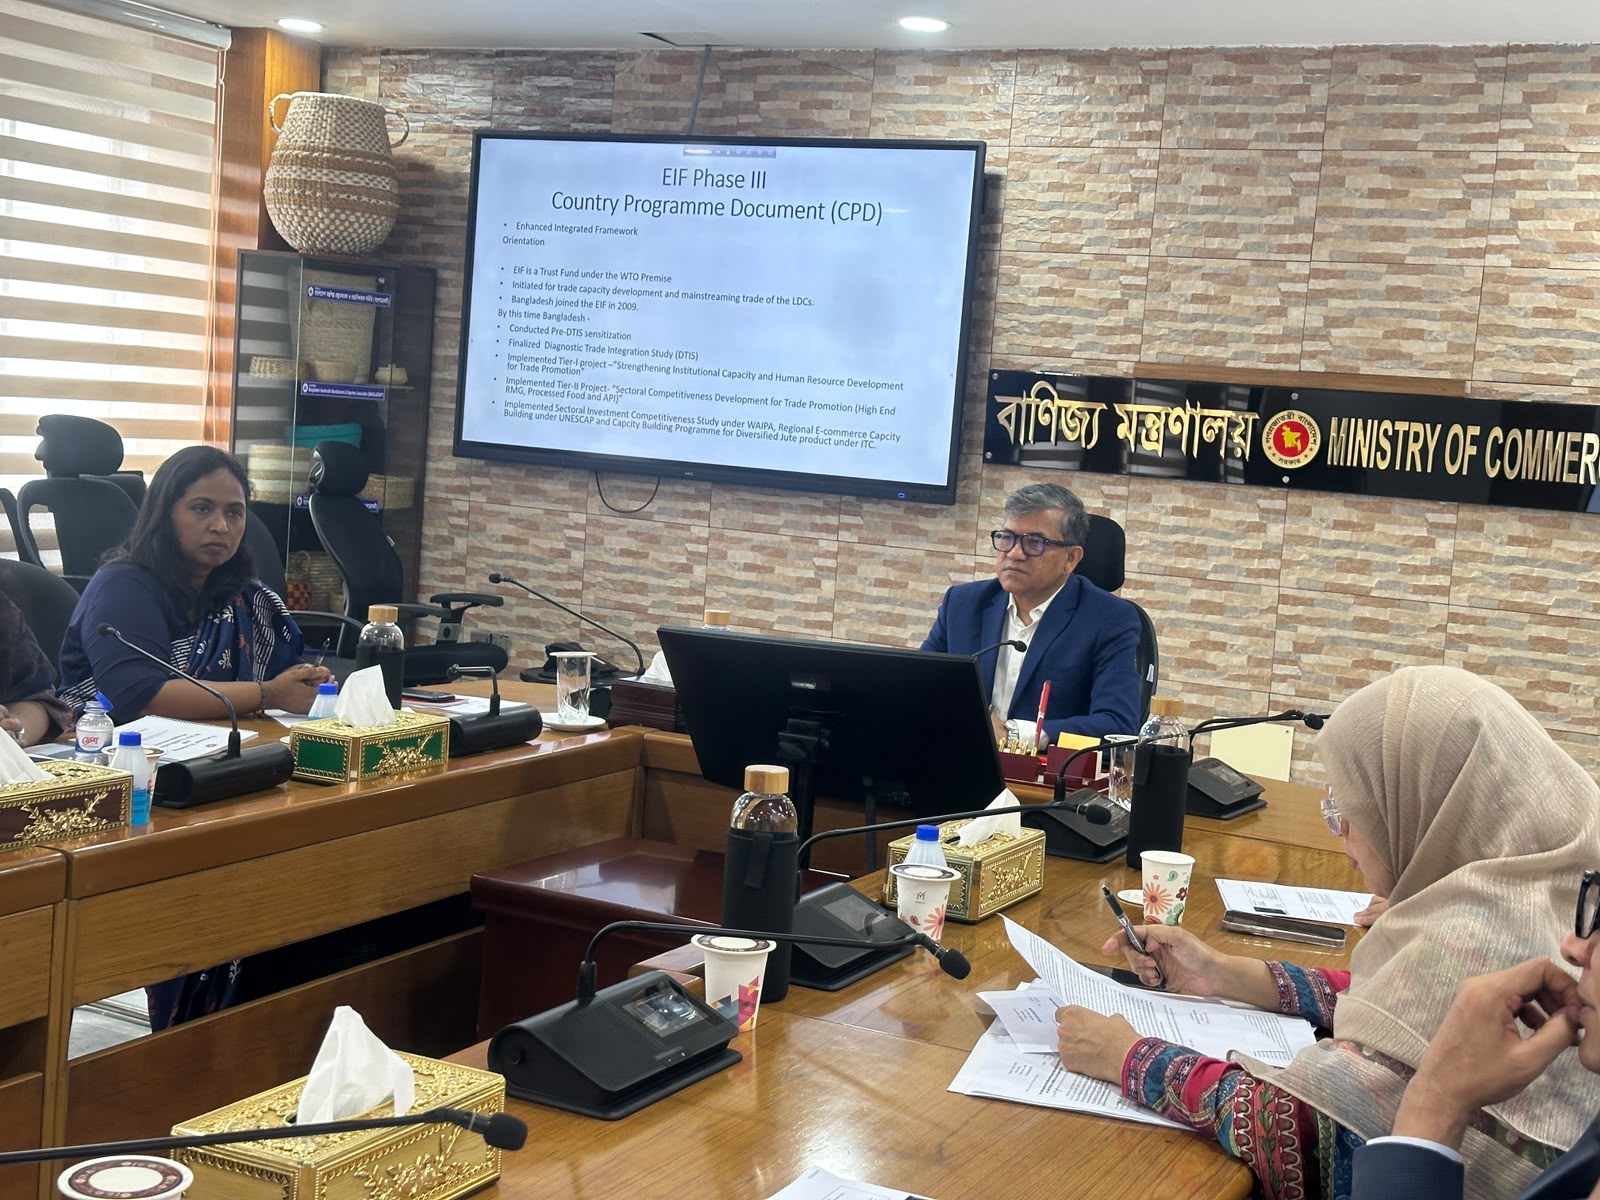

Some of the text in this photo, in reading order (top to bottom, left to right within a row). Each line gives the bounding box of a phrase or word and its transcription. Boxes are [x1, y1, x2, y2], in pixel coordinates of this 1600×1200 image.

[662, 168, 766, 189] EIF Phase III
[552, 191, 882, 226] Country Programme Document (CPD)
[516, 222, 638, 236] Enhanced Integrated Framework
[502, 236, 545, 246] Orientation
[514, 266, 525, 274] EIF
[526, 266, 532, 275] is
[540, 267, 558, 277] Trust
[560, 268, 579, 278] Fund
[581, 270, 604, 279] under
[605, 271, 618, 280] the
[620, 272, 639, 281] WTO
[641, 273, 672, 283] Premise
[512, 281, 814, 306] Initiated for trade capacity development and mainstreaming trade of the LDCs.
[512, 295, 639, 311] Bangladesh joined the EIF in 2009.
[498, 308, 508, 318] By
[509, 309, 522, 318] this
[524, 310, 541, 320] time
[542, 311, 586, 323] Bangladesh
[509, 324, 632, 340] Conducted Pre-DTIS sensitization
[508, 338, 699, 362] Finalized Diagnostic Trade Integration Study (DTIS)
[507, 361, 518, 370] for
[520, 363, 540, 373] Trade
[508, 353, 557, 367] Implemented
[559, 357, 578, 366] Tier-I
[580, 360, 607, 370] project
[673, 365, 720, 377] Institutional
[722, 369, 757, 381] Capacity
[758, 372, 774, 381] and
[775, 373, 805, 383] Human
[807, 375, 845, 387] Resource
[847, 378, 904, 391] Development
[506, 376, 556, 389] Implemented
[557, 380, 579, 390] Tier-II
[648, 388, 713, 401] Competitiveness
[715, 393, 768, 406] Development
[770, 397, 782, 406] for
[784, 398, 807, 409] Trade
[809, 400, 853, 412] Promotion
[855, 404, 877, 416] (High
[879, 406, 896, 416] End
[528, 387, 565, 398] Processed
[566, 390, 586, 400] Food
[587, 392, 602, 401] and
[504, 400, 554, 414] Implemented
[555, 404, 586, 414] Sectoral
[587, 407, 629, 418] Investment
[631, 410, 695, 425] Competitiveness
[697, 416, 720, 428] Study
[721, 419, 745, 428] under
[778, 423, 814, 435] Regional
[816, 426, 868, 439] E-commerce
[504, 408, 533, 421] Building
[535, 412, 558, 421] under
[559, 414, 594, 424] UNESCAP
[596, 417, 611, 426] and
[642, 420, 673, 434] Building
[675, 424, 721, 436] Programme
[723, 427, 734, 437] for
[736, 429, 779, 441] Diversified
[780, 432, 797, 442] Jute
[799, 435, 832, 446] product
[834, 438, 859, 448] under
[994, 380, 1260, 461] বাণিজ্য মন্ত্রণালয়
[1328, 416, 1600, 485] MINISTRY OF COMMER
